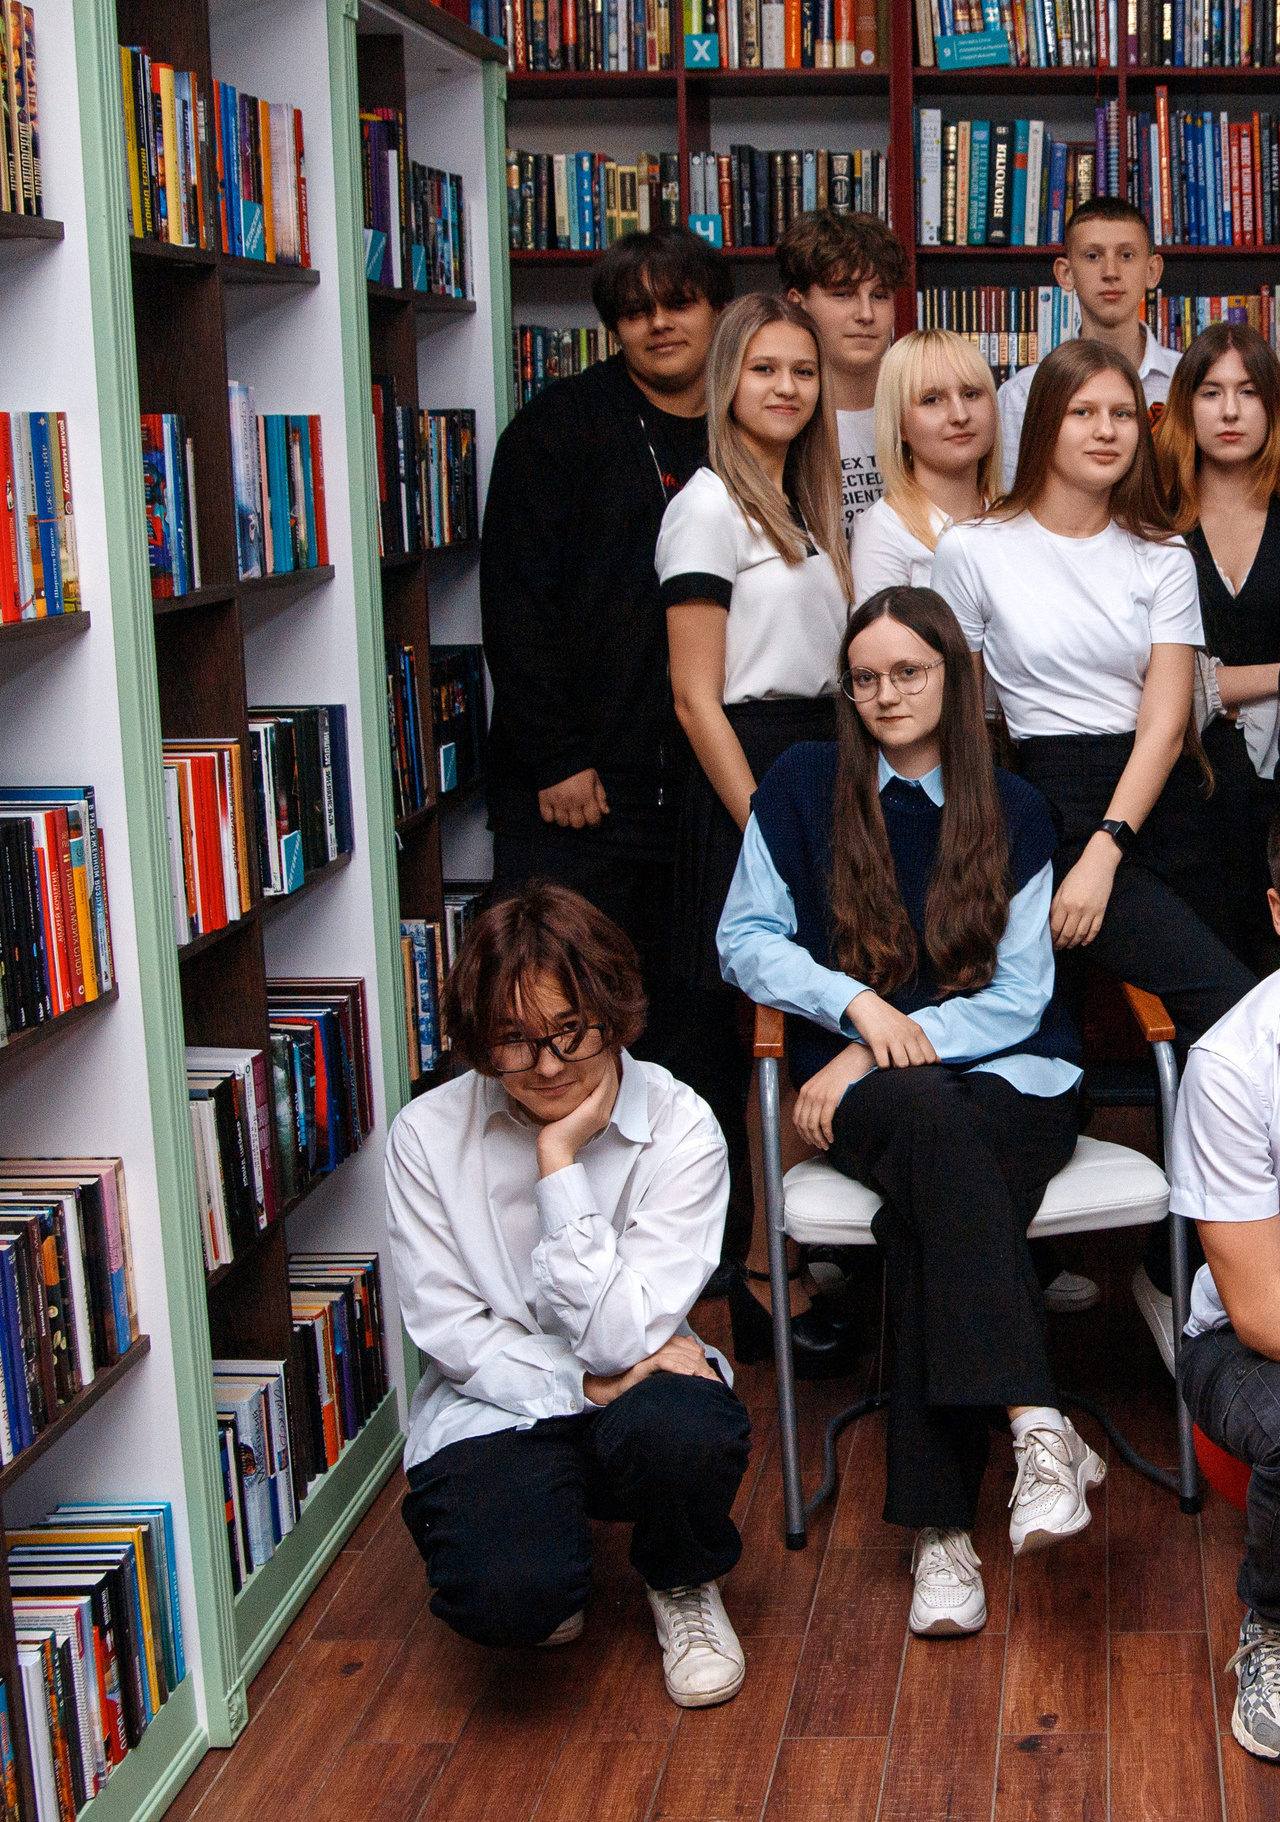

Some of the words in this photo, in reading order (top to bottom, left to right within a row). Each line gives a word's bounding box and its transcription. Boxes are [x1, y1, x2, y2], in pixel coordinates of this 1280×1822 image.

[140, 147, 149, 186] БЕЖИН
[993, 143, 1008, 218] БИОЛОГИЯ
[142, 189, 152, 232] ЛЕОНИД
[57, 419, 66, 448] КОЛИН
[41, 443, 50, 468] ЭЙР
[61, 449, 72, 495] МАККАЛОУ
[44, 470, 54, 515] ДЖЕЙН
[50, 870, 61, 912] КОЧЕРГИН
[65, 867, 77, 913] ТИШИНА
[54, 912, 64, 943] АНДРЕЙ
[70, 914, 79, 942] МОИХ
[73, 946, 83, 976] СЛОВ
